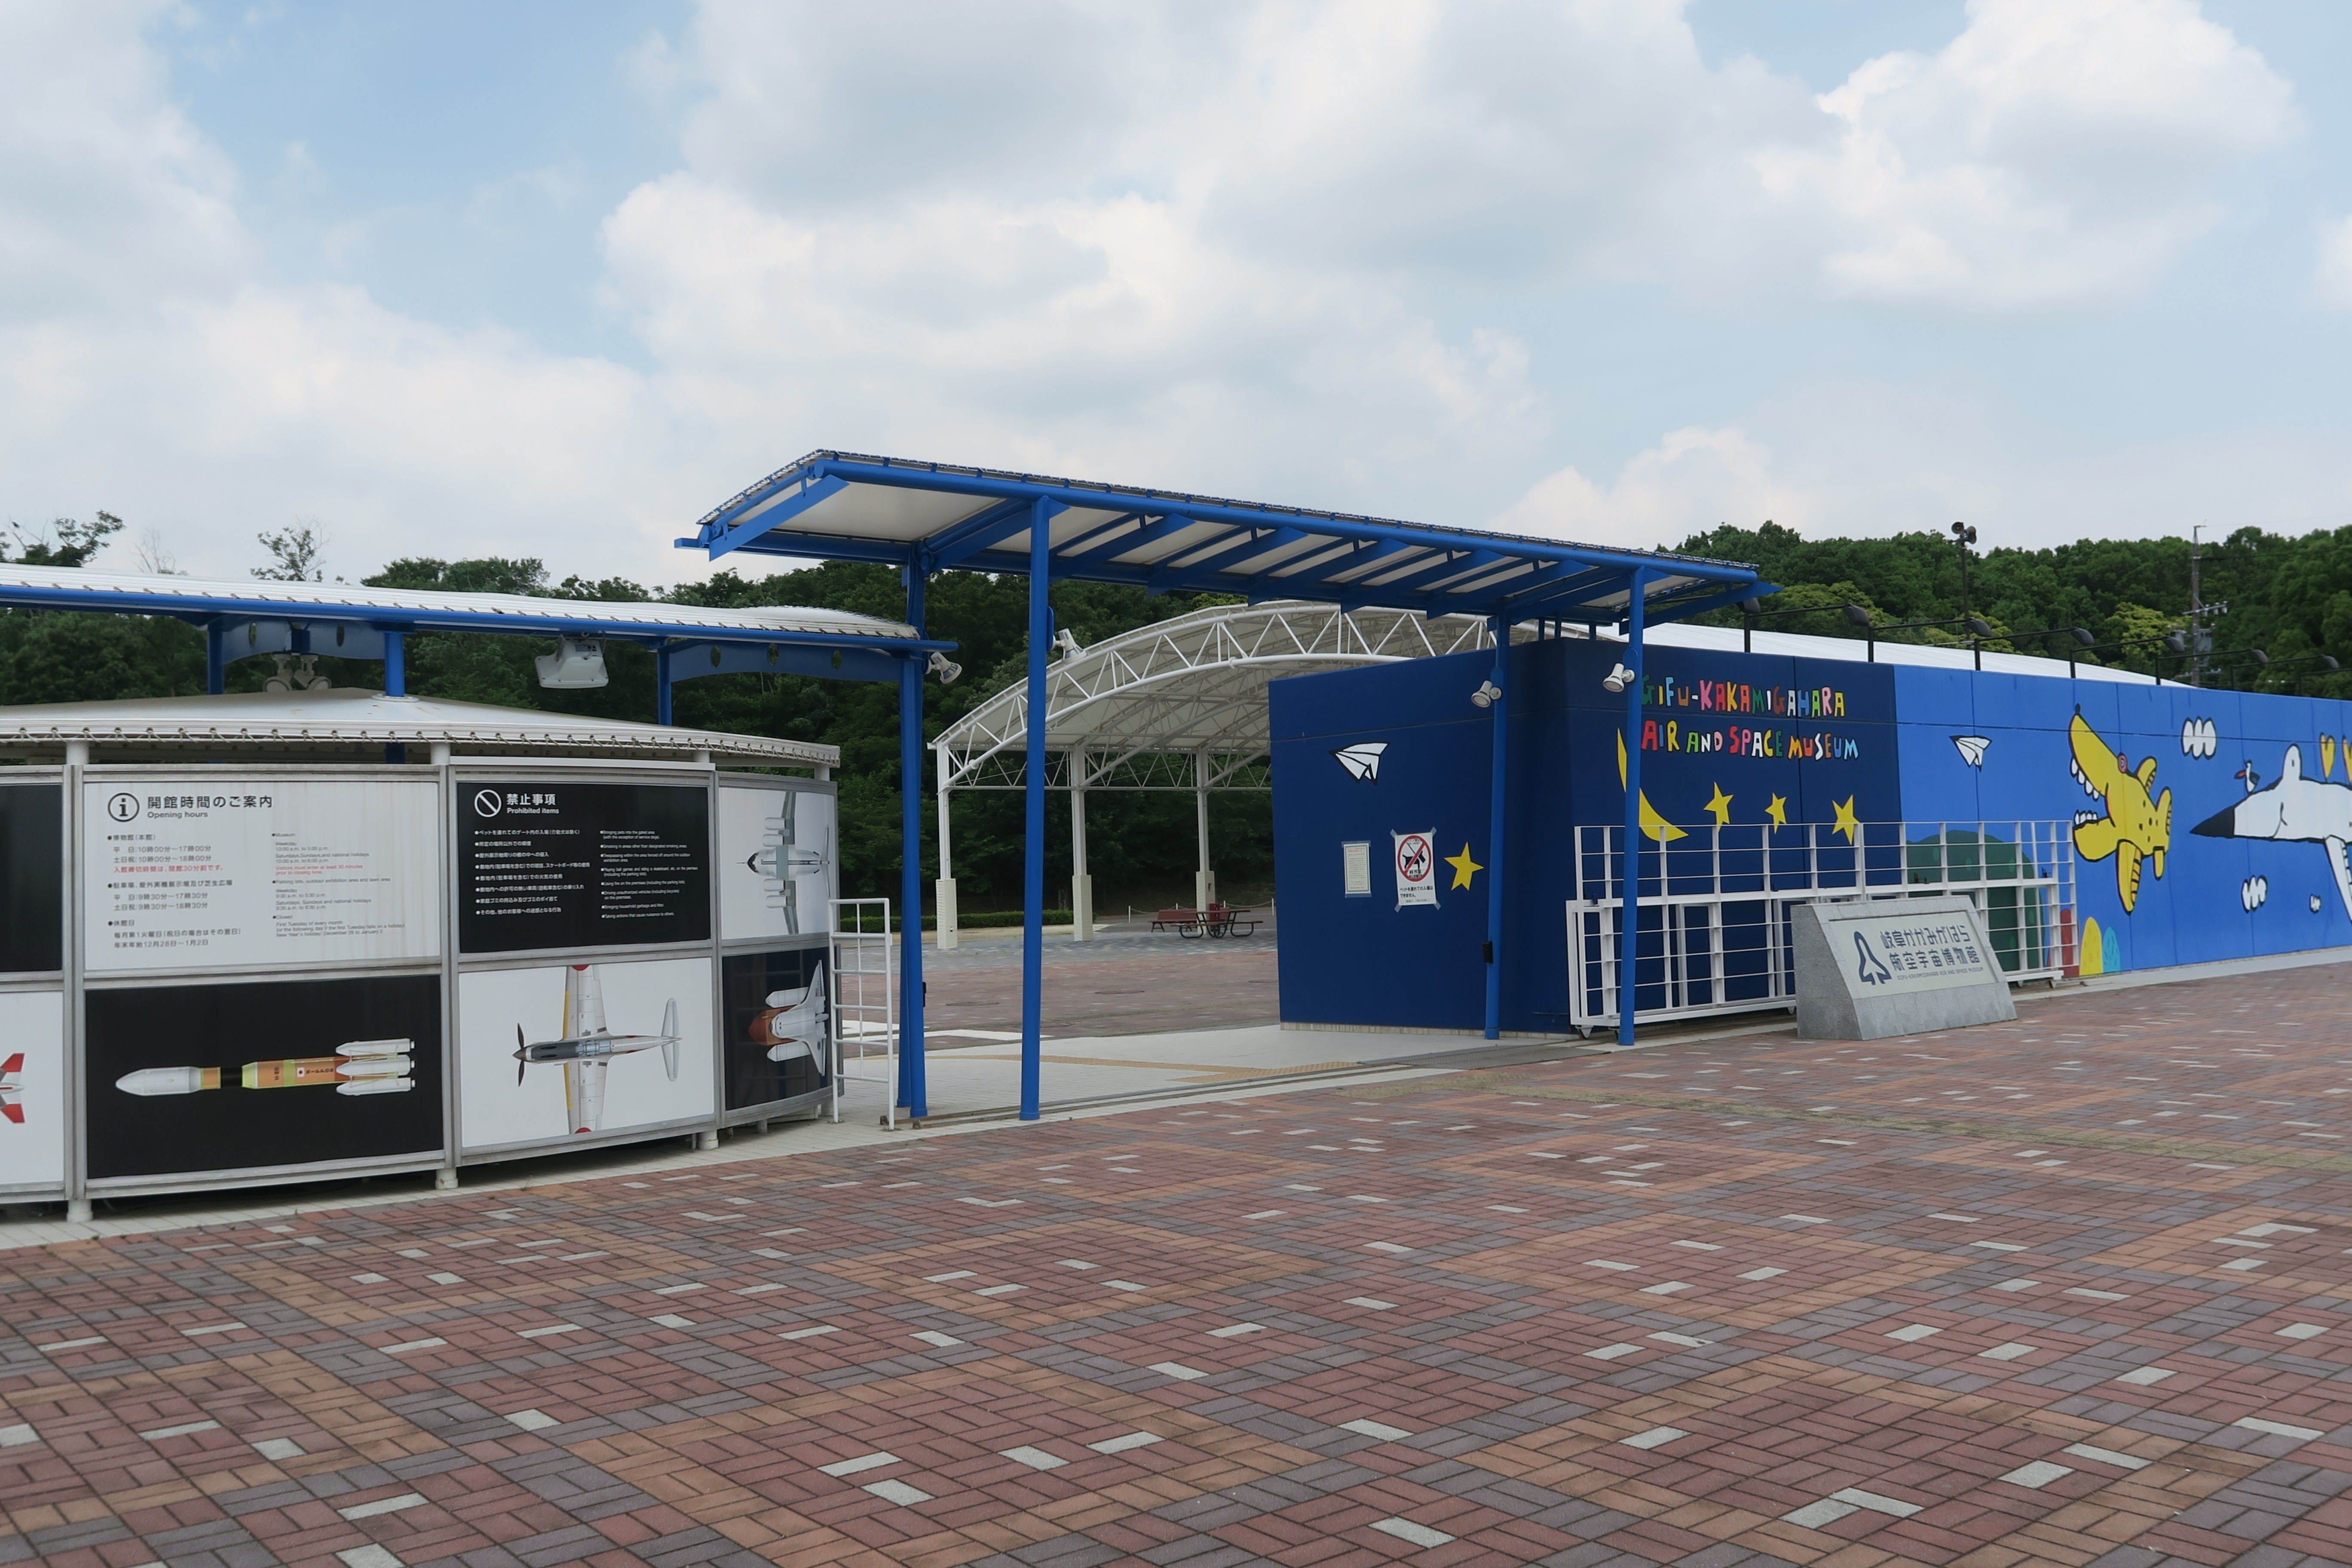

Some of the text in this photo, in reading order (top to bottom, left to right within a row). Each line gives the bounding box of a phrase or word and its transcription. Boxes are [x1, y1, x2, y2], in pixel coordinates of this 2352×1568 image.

[1642, 675, 1845, 717] GIFU-KAKAMIGAHARA
[1641, 720, 1859, 760] AIR AND SPACE MUSEUM
[147, 795, 273, 809] 開館時間のご案内
[506, 793, 556, 805] 禁止事項
[147, 811, 182, 819] Opening
[1880, 925, 1971, 949] 岐阜かかみがはら
[1889, 946, 1980, 971] 航空宇宙博物館
